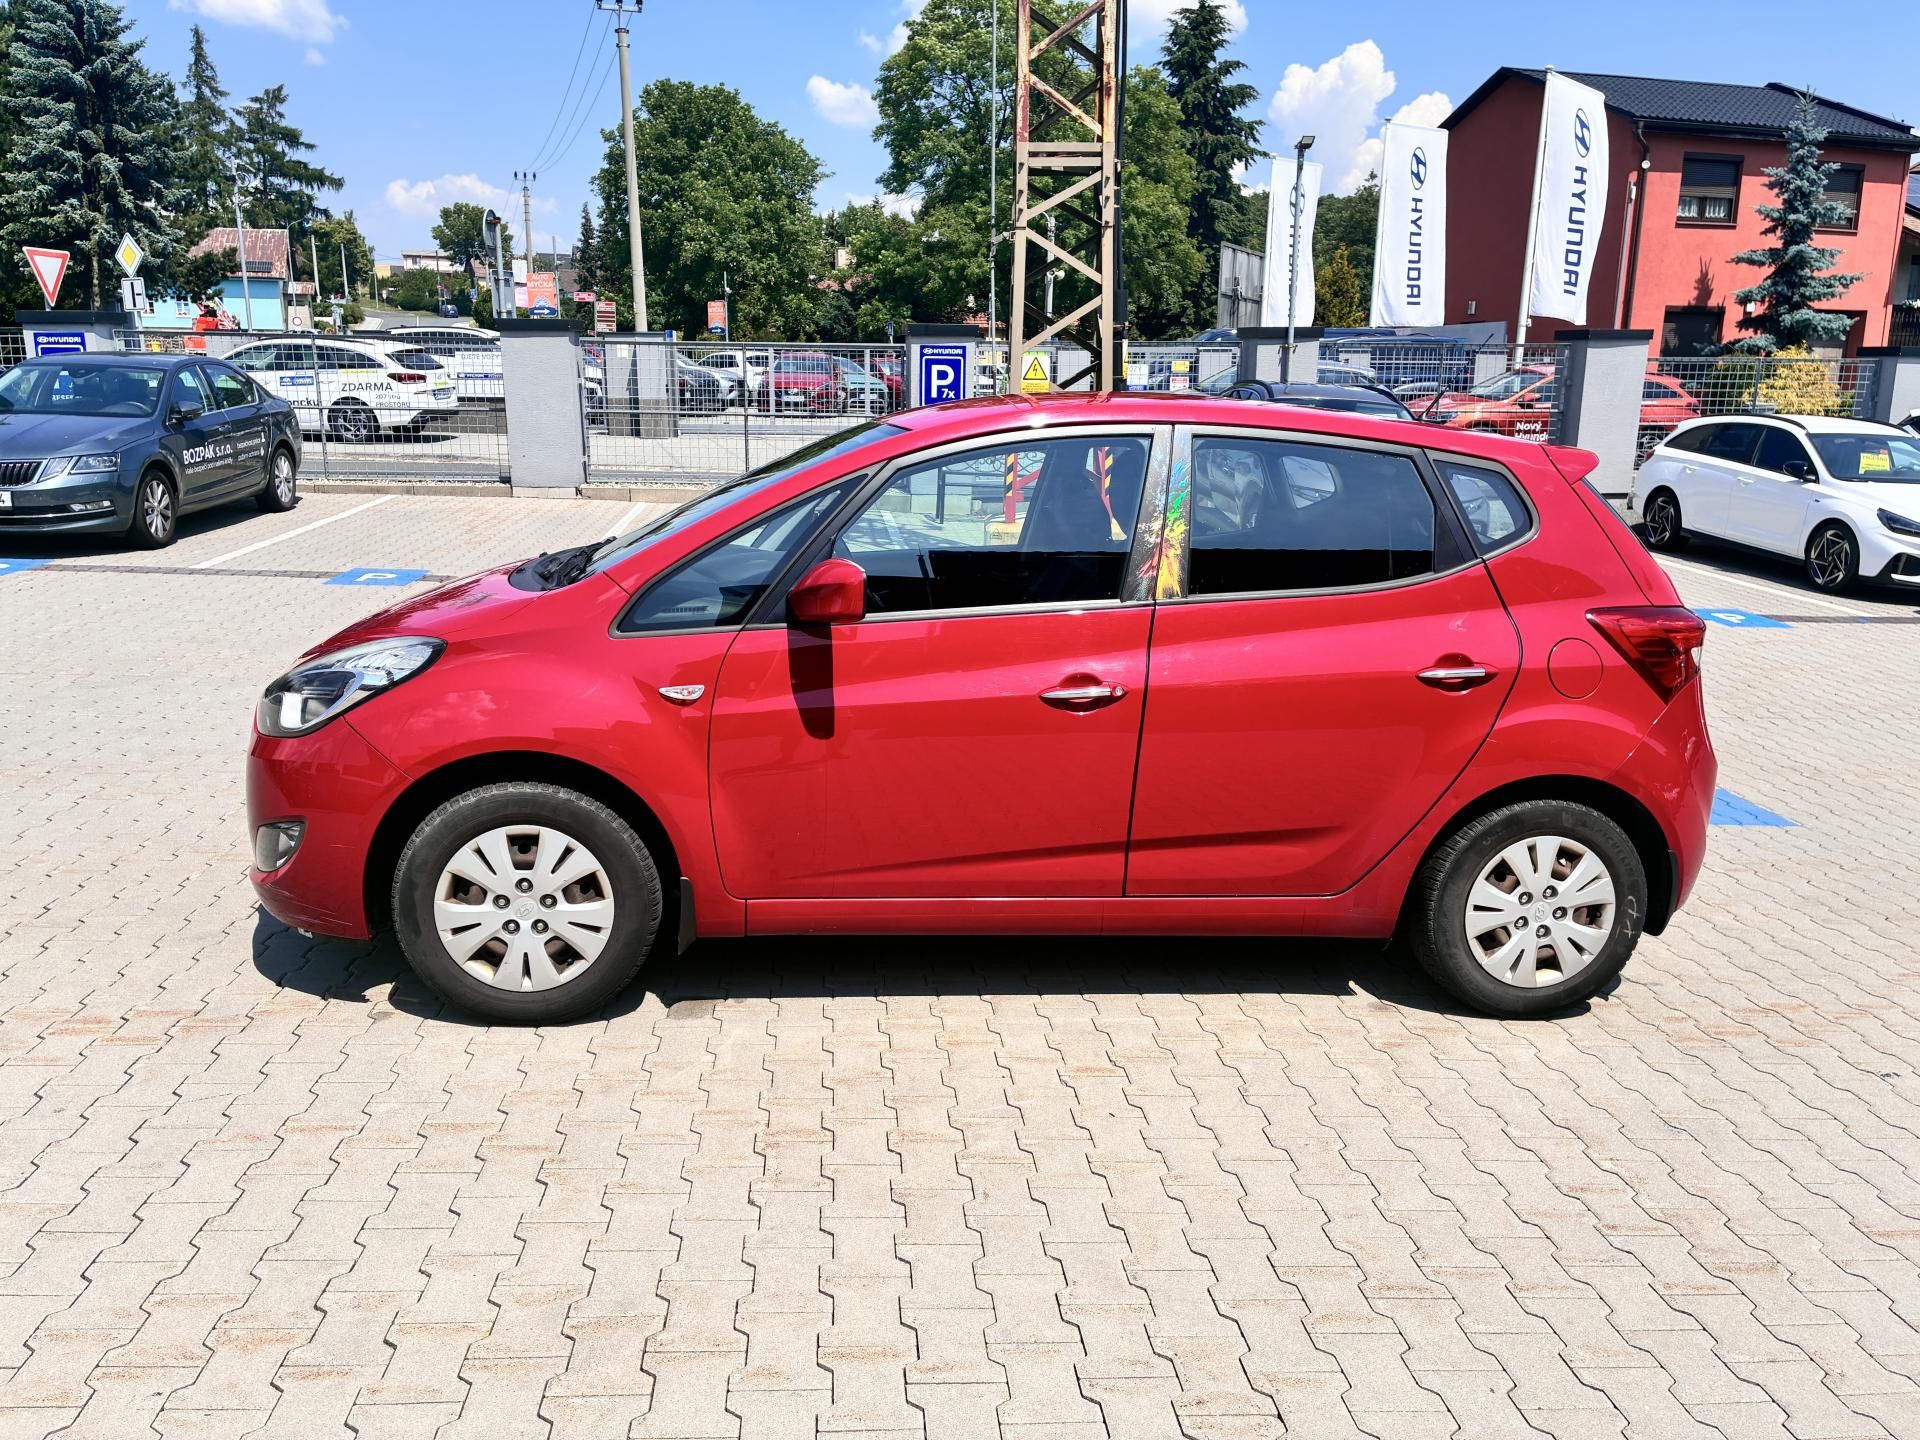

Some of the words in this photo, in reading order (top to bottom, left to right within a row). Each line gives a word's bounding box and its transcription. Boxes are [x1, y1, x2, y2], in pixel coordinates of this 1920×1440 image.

[1563, 165, 1588, 296] HYUNDAI
[1406, 197, 1423, 306] HYUNDAI
[341, 382, 393, 391] ZDARMA
[931, 364, 955, 398] P
[941, 388, 955, 399] 7x
[1516, 421, 1543, 432] Nový
[183, 442, 215, 465] BOZPÁK
[216, 444, 233, 457] s.r.o.
